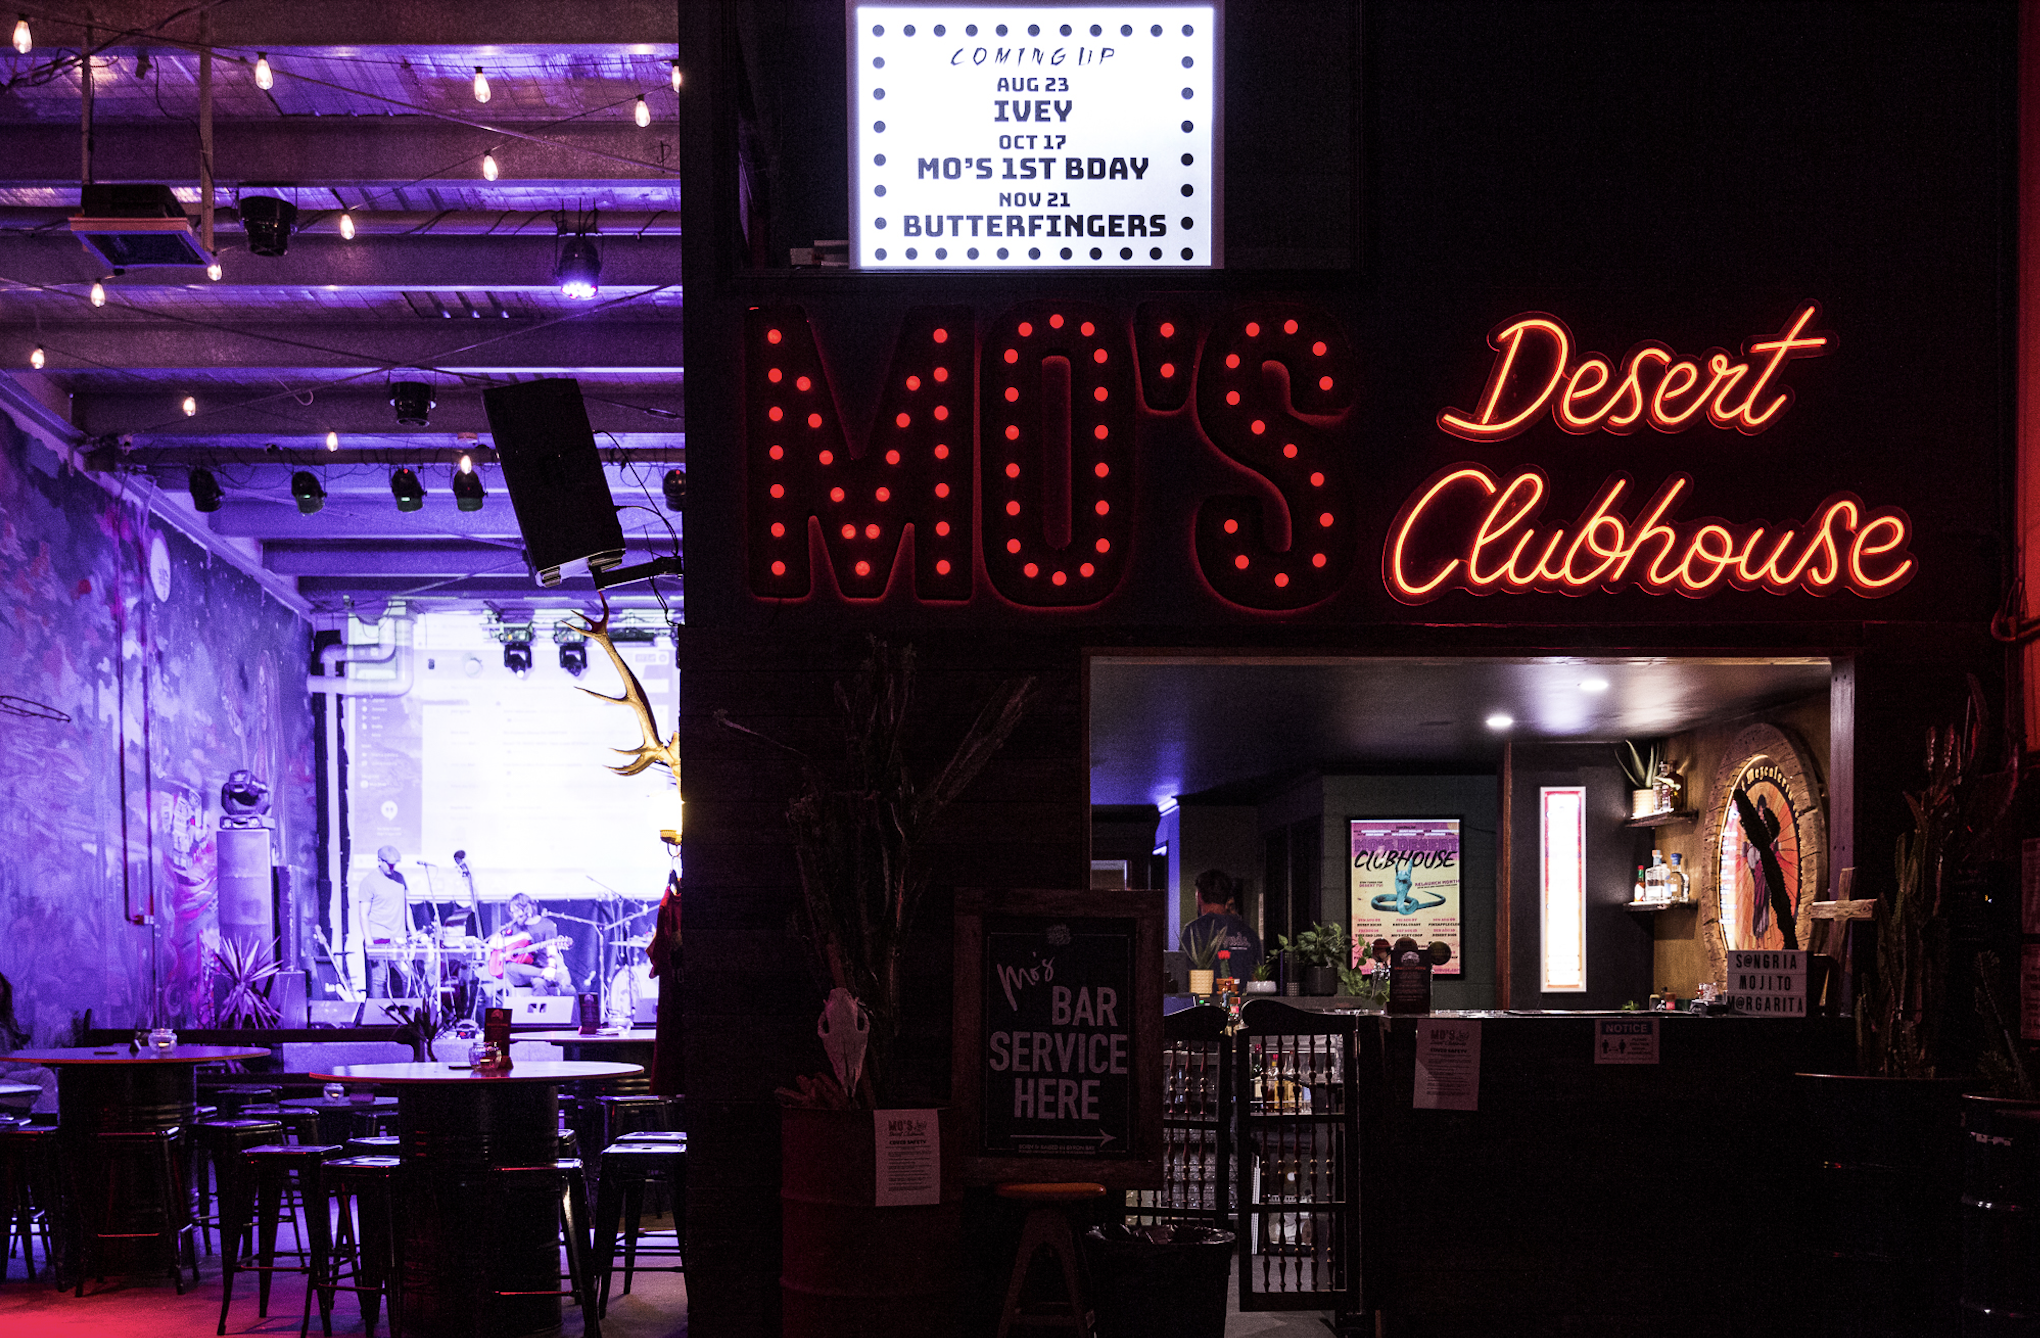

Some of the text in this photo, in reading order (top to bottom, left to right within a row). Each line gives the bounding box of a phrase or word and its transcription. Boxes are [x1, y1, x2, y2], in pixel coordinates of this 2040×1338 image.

[950, 47, 1067, 67] COMING
[997, 78, 1070, 93] AUG 23
[994, 100, 1073, 123] IVEY
[999, 135, 1067, 150] OCT 17
[917, 157, 1149, 180] MO'S 1ST BDAY
[999, 192, 1071, 208] NOV 21
[903, 215, 1167, 237] BUTTERFINGERS
[1441, 306, 1828, 432] Desert
[745, 302, 1357, 612] MO'S
[1394, 468, 1913, 595] Clubhouse
[1354, 850, 1458, 872] CLUBHOUSE
[1736, 954, 1797, 970] S@NGRIA
[1739, 975, 1791, 991] MOJITO
[1051, 985, 1118, 1027] BAR
[1727, 995, 1803, 1012] M@RGARITA
[1605, 1024, 1648, 1033] NOTICE
[989, 1031, 1128, 1074] SERVICE
[1014, 1077, 1100, 1120] HERE
